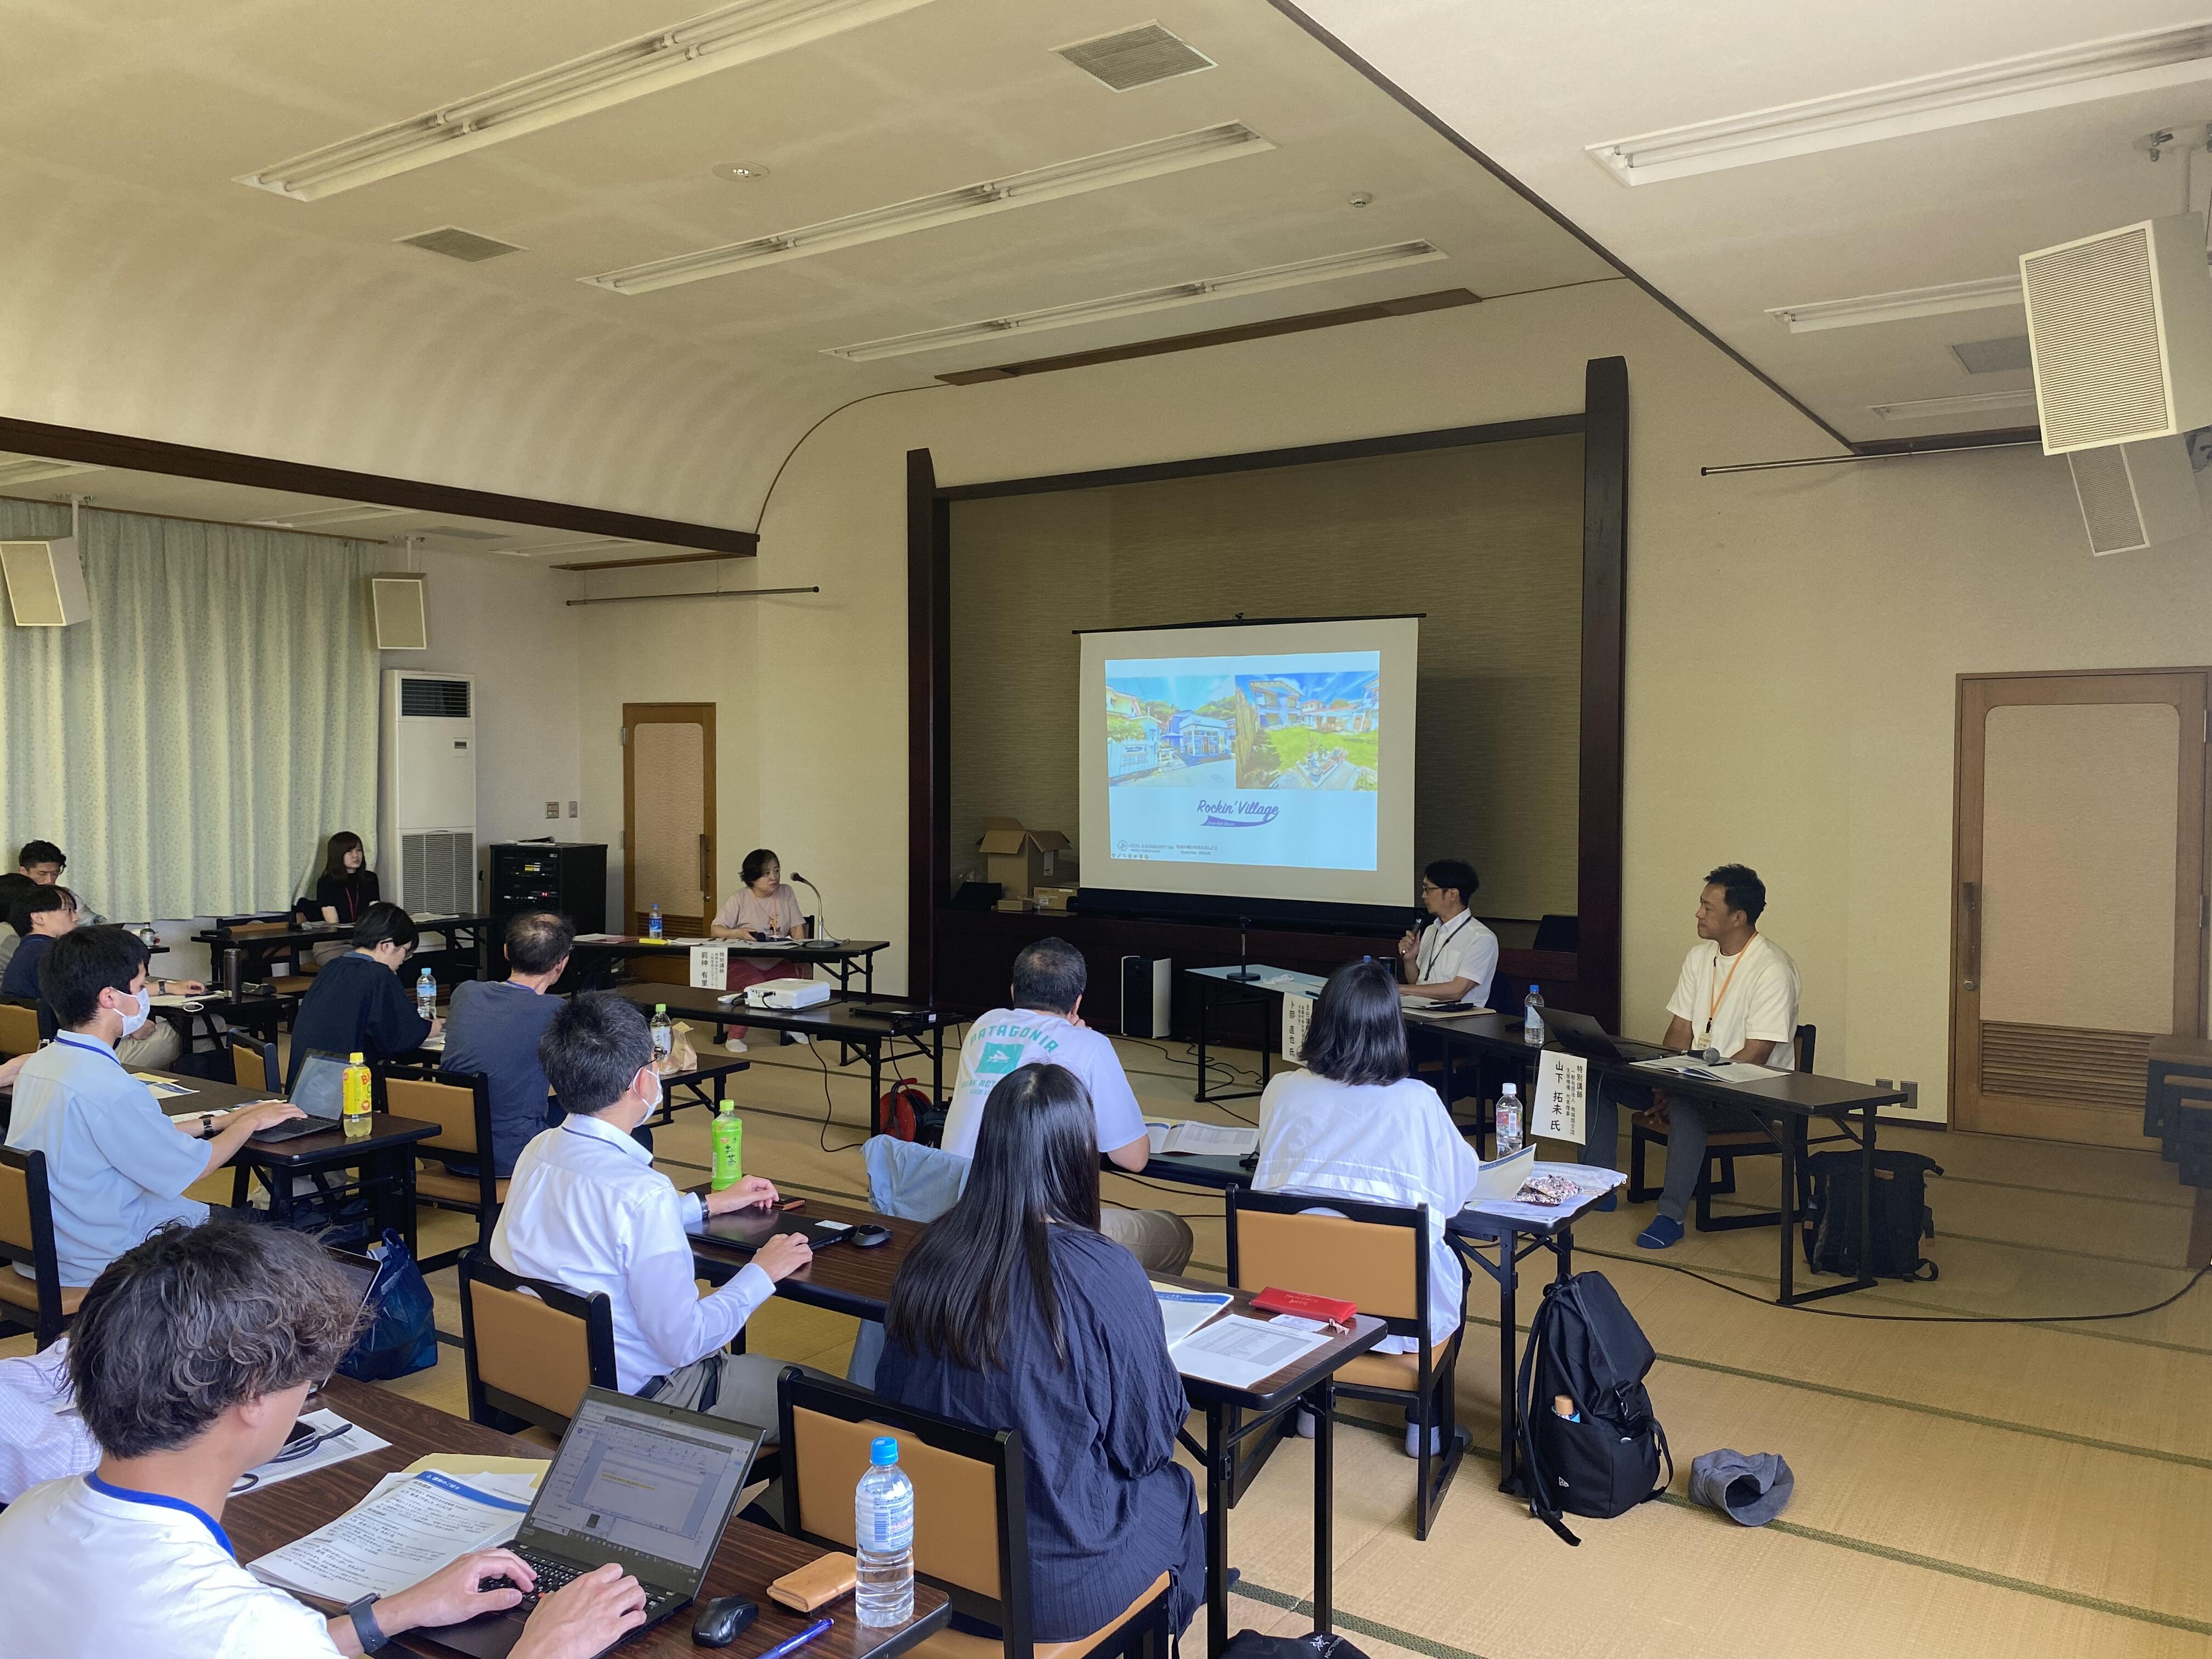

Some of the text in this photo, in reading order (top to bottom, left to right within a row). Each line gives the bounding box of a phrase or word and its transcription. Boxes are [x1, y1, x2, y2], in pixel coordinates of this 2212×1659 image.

[1197, 799, 1279, 821] Rockin' Village
[701, 972, 708, 986] 有里
[970, 1024, 1059, 1052] PATAGONIA
[979, 1079, 997, 1087] ACT
[1550, 1060, 1563, 1131] 山下 拓未 氏
